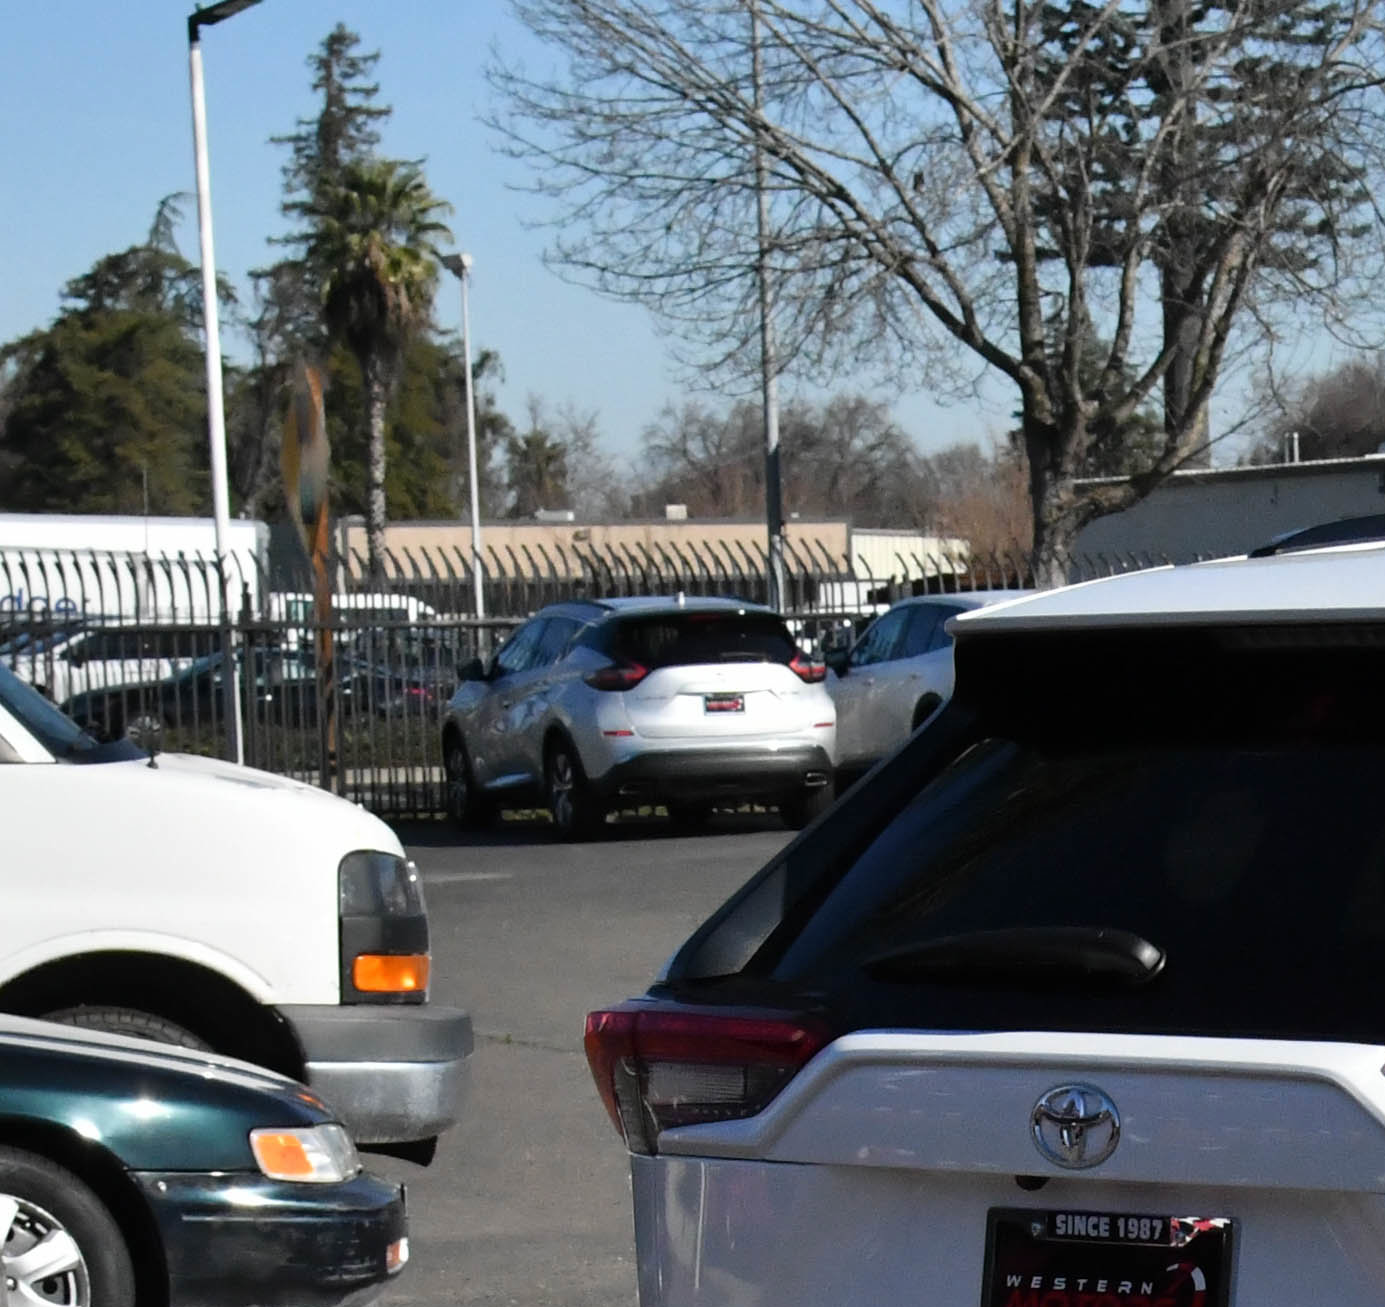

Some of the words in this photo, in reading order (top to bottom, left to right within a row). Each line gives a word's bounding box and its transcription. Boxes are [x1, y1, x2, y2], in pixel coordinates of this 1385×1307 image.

[1055, 1214, 1110, 1238] SINCE
[1118, 1218, 1163, 1240] 1987
[1006, 1274, 1153, 1295] WESTERN
